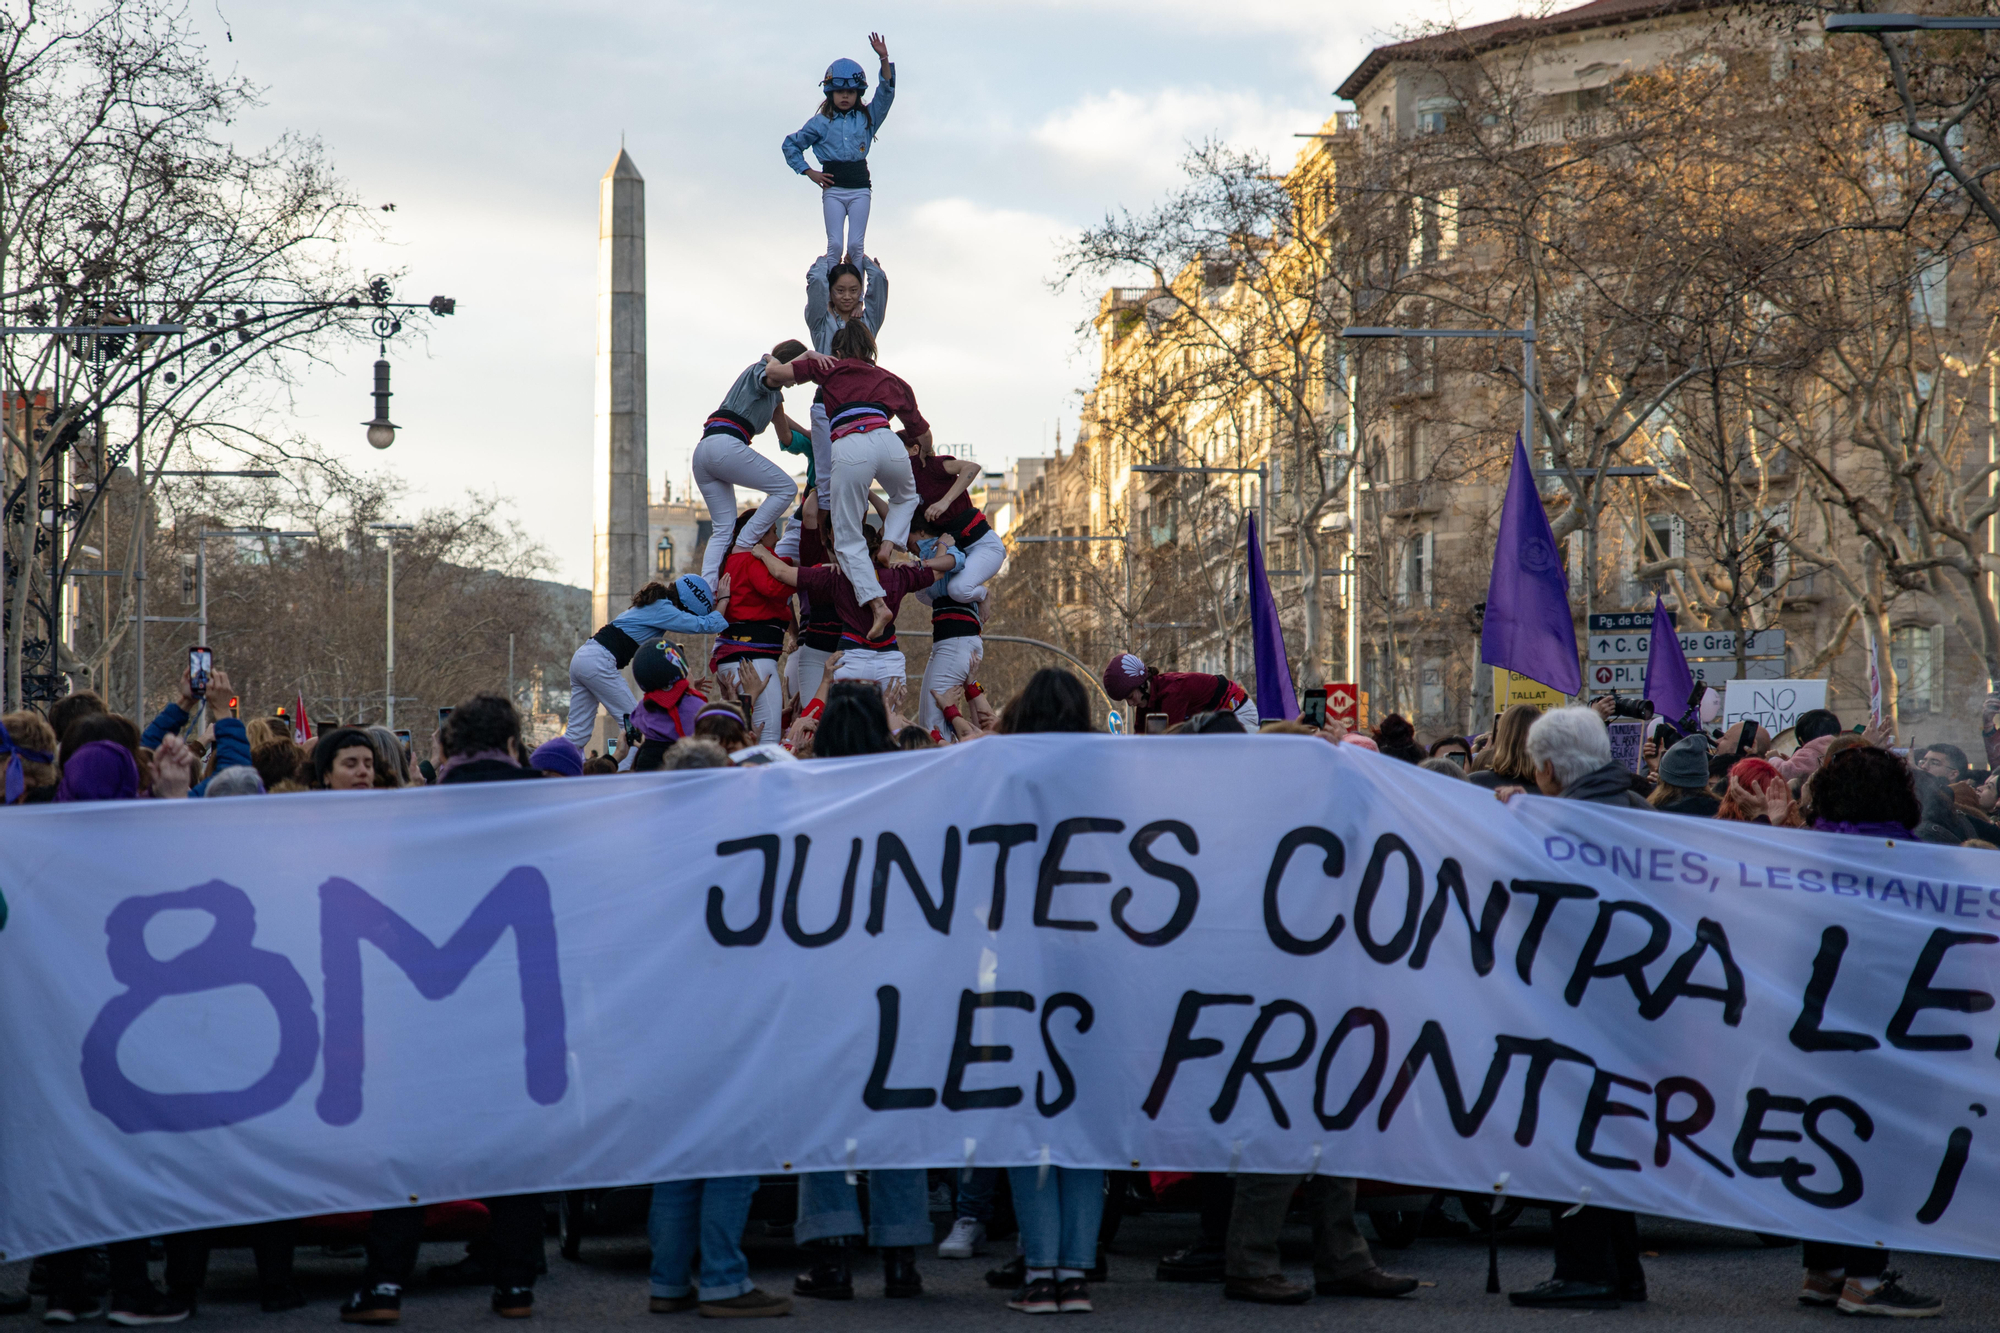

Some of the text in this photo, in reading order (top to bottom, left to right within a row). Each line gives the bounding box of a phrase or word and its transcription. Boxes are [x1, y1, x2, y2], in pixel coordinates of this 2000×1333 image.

[933, 443, 977, 457] OTEL
[1599, 614, 1655, 628] Pg. de Grà
[1615, 637, 1631, 652] C.
[1680, 636, 1698, 650] de
[1703, 634, 1755, 650] Gràa
[1615, 667, 1634, 682] Pl.
[1333, 696, 1346, 707] M
[1511, 691, 1547, 699] TALLAT
[1754, 688, 1796, 711] NO
[1611, 724, 1638, 735] MUNDIAL
[1611, 736, 1619, 746] AL
[1544, 835, 2000, 920] DONES, LESBIANES
[705, 816, 2000, 1054] JUNTES CONTRA LE
[79, 866, 569, 1137] 8M
[862, 984, 1096, 1119] LES
[1140, 989, 1877, 1210] FRONTERES
